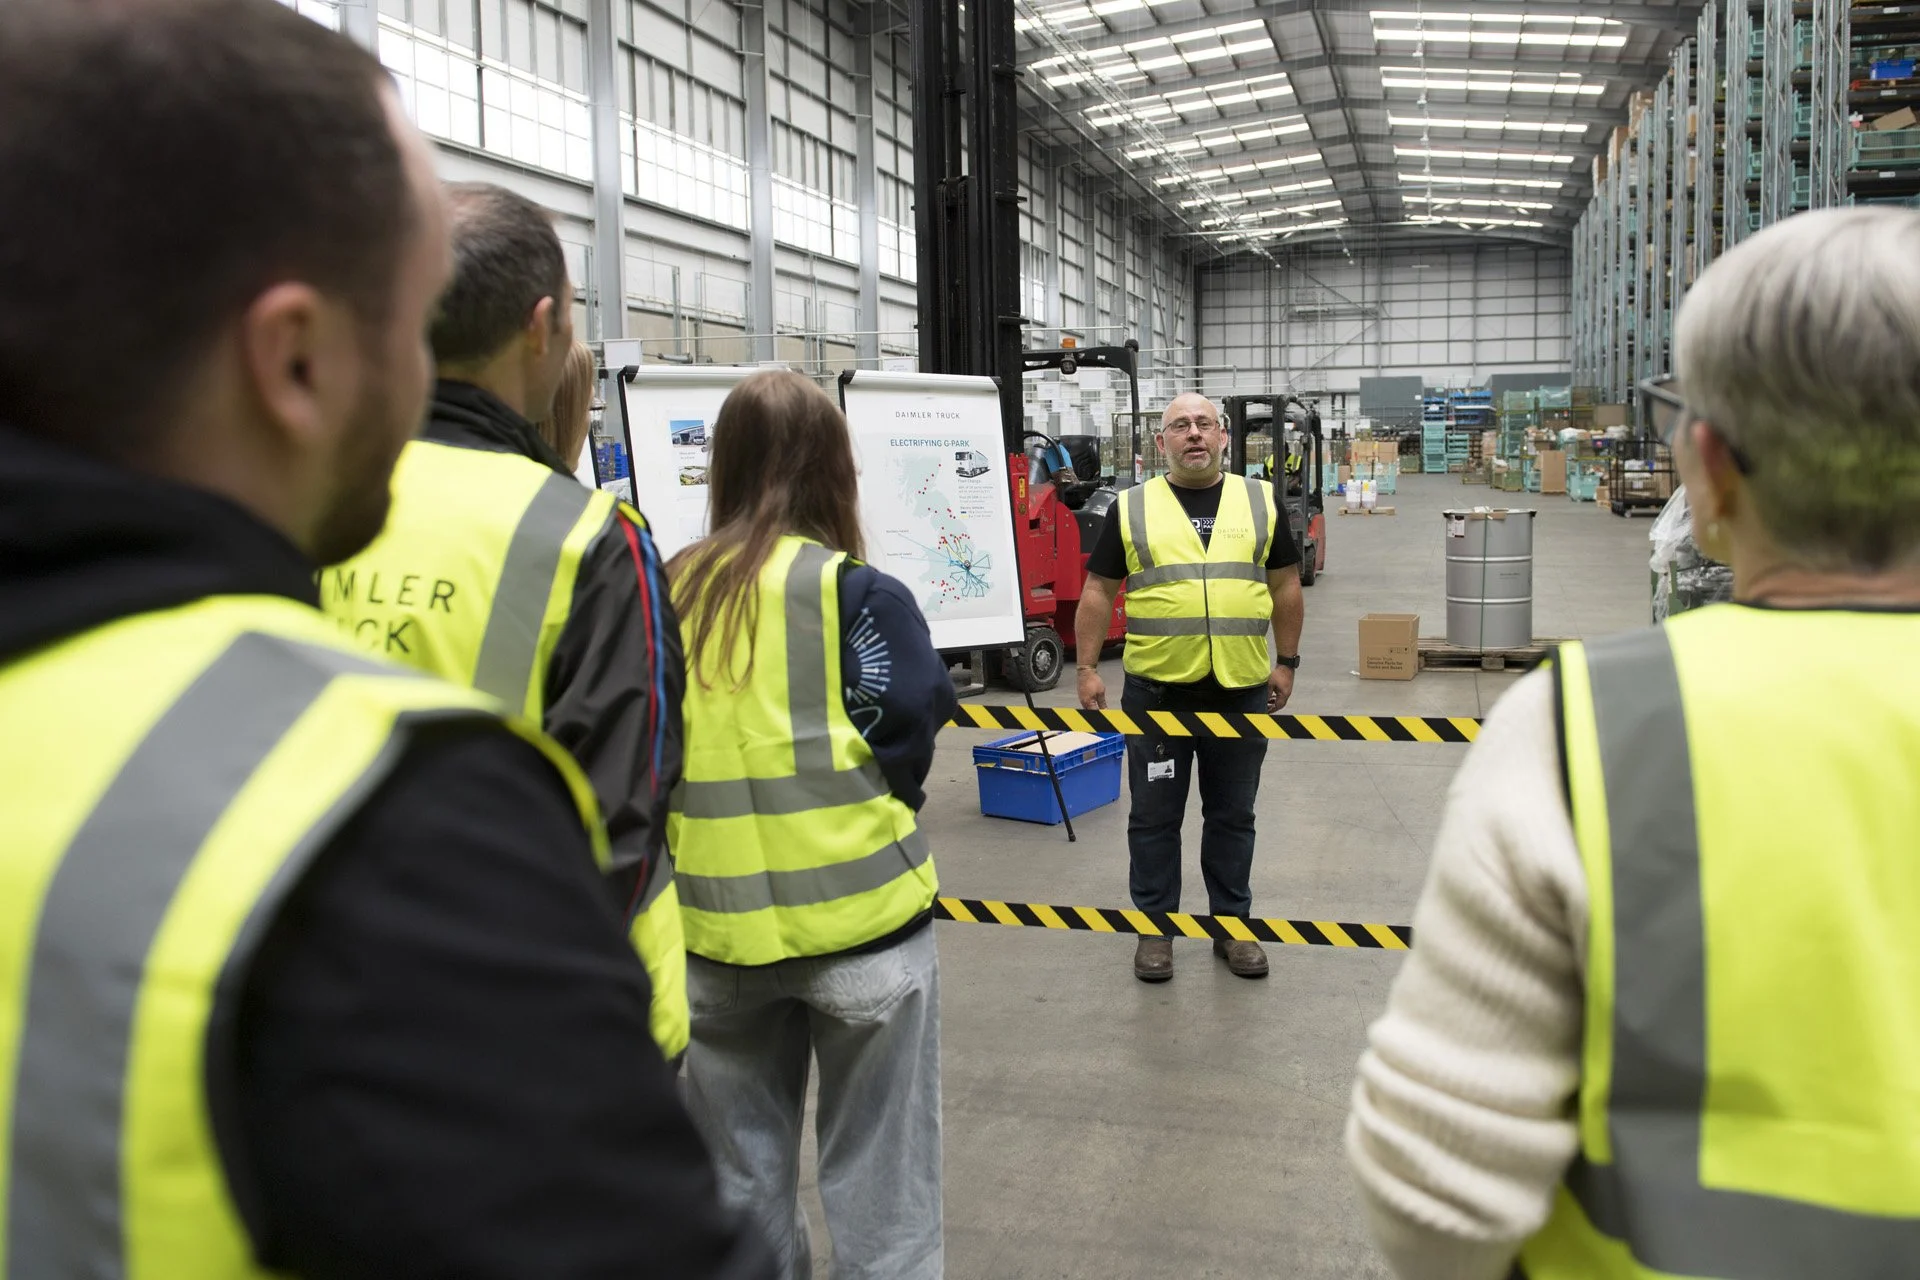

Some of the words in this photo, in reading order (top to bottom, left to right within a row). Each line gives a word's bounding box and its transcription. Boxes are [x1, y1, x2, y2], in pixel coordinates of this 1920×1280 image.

[895, 411, 932, 419] DAIMLER
[890, 439, 943, 447] ELECTRIFYING
[943, 440, 970, 448] G-PARK
